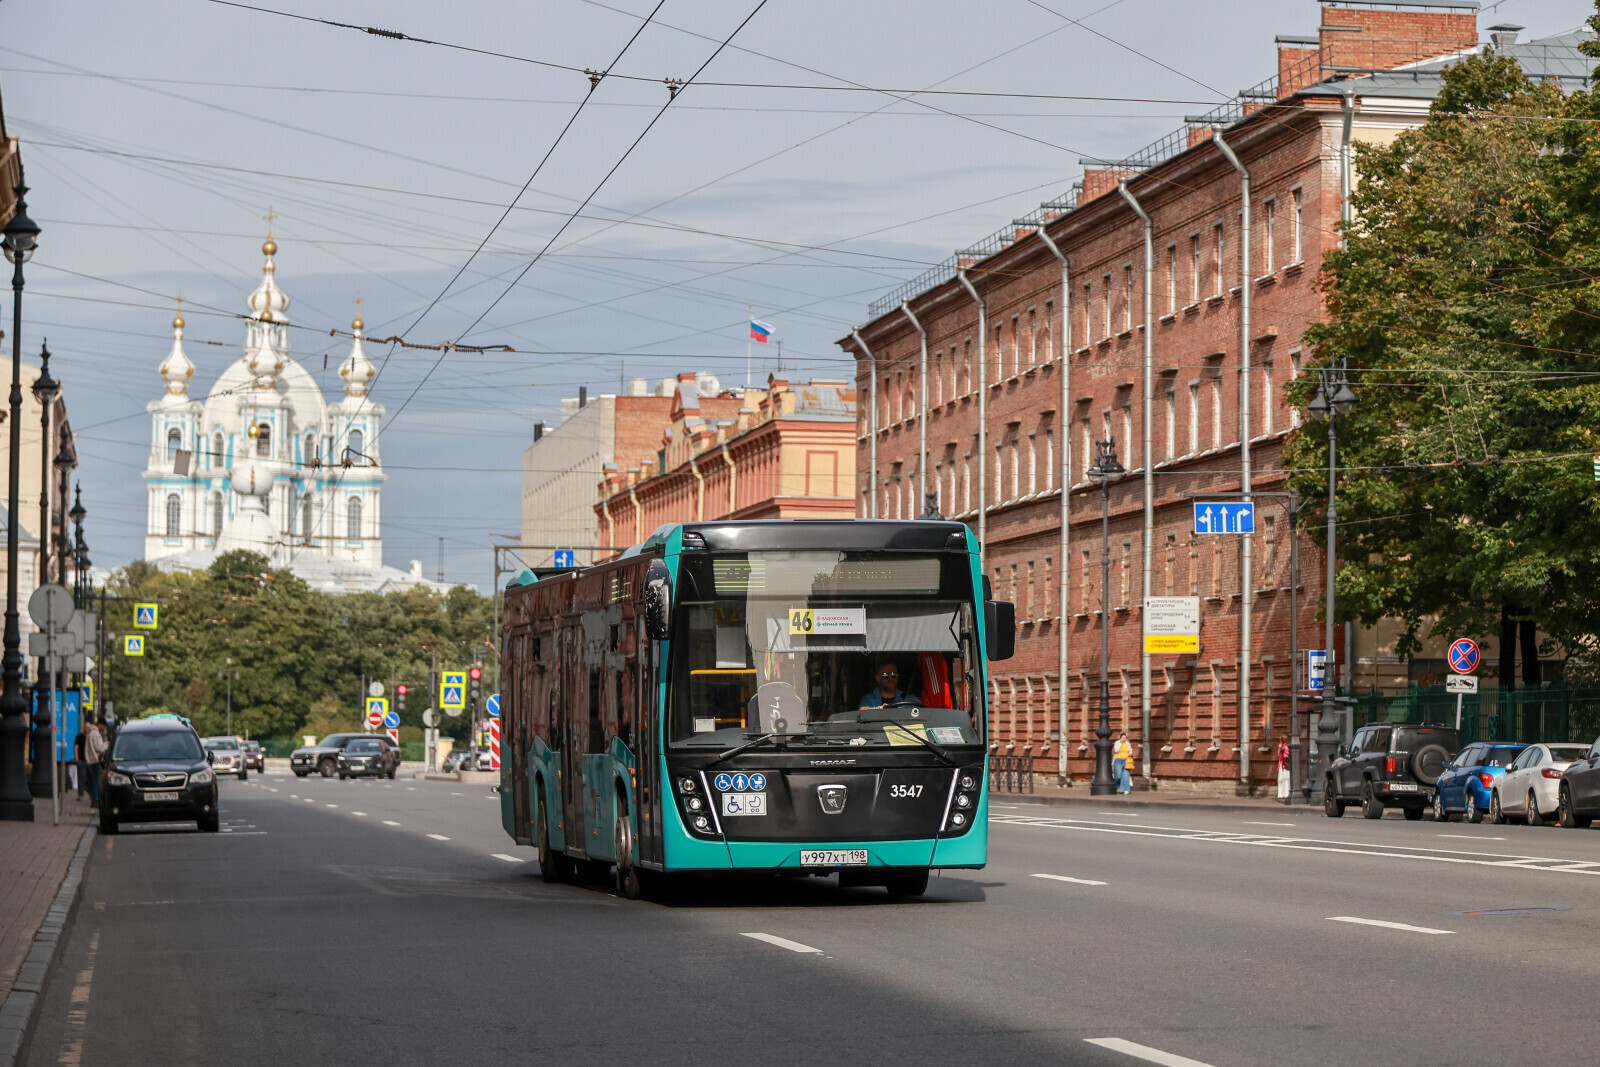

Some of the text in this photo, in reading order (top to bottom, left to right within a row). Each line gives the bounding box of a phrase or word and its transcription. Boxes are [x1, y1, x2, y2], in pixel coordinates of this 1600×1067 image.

[792, 611, 812, 631] 46
[890, 785, 923, 798] 3547
[804, 852, 846, 862] У997ХТ
[849, 851, 866, 860] 198
